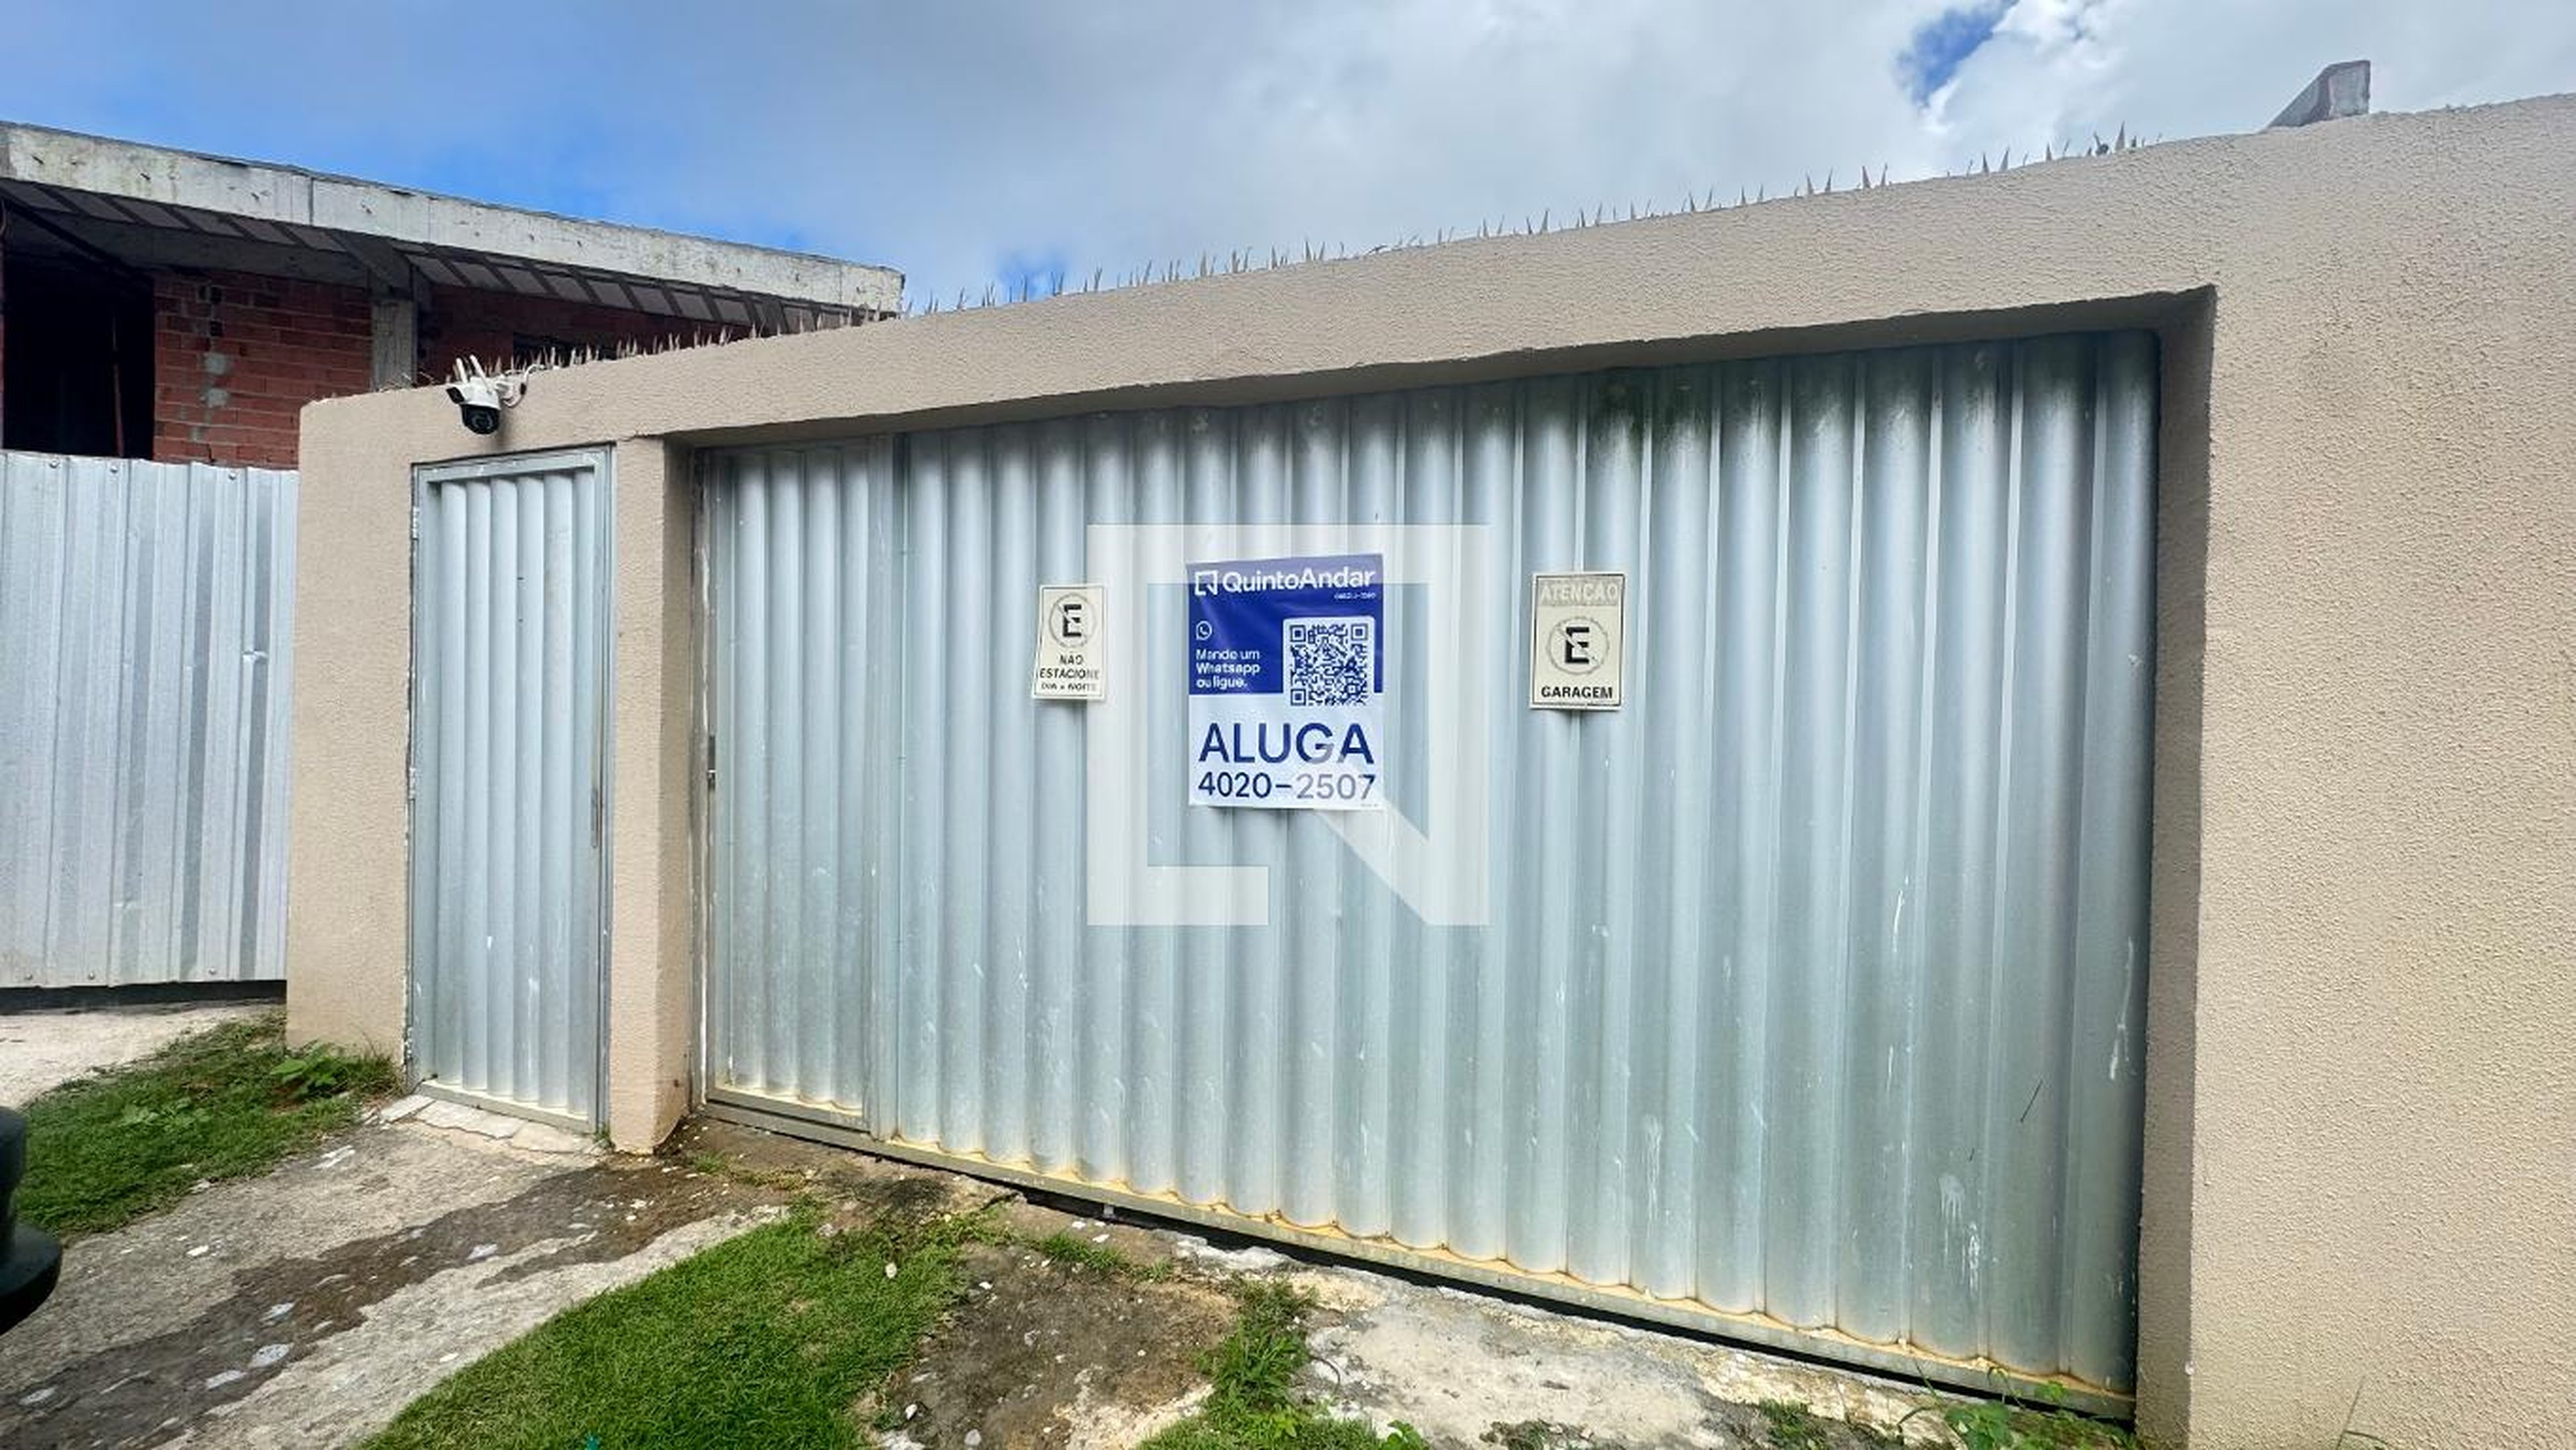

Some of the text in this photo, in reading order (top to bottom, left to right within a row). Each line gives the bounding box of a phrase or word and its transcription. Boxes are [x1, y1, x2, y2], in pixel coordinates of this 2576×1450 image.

[1222, 567, 1376, 593] QuintoAndar
[1196, 649, 1260, 660] Mande um
[1040, 668, 1099, 679] ESTACIONE
[1195, 662, 1260, 676] Whatsapp
[1196, 676, 1248, 690] ou ligue.
[1541, 686, 1613, 698] GARAGEM
[1199, 723, 1374, 764] ALUGA
[1198, 772, 1375, 800] 4020-2507
